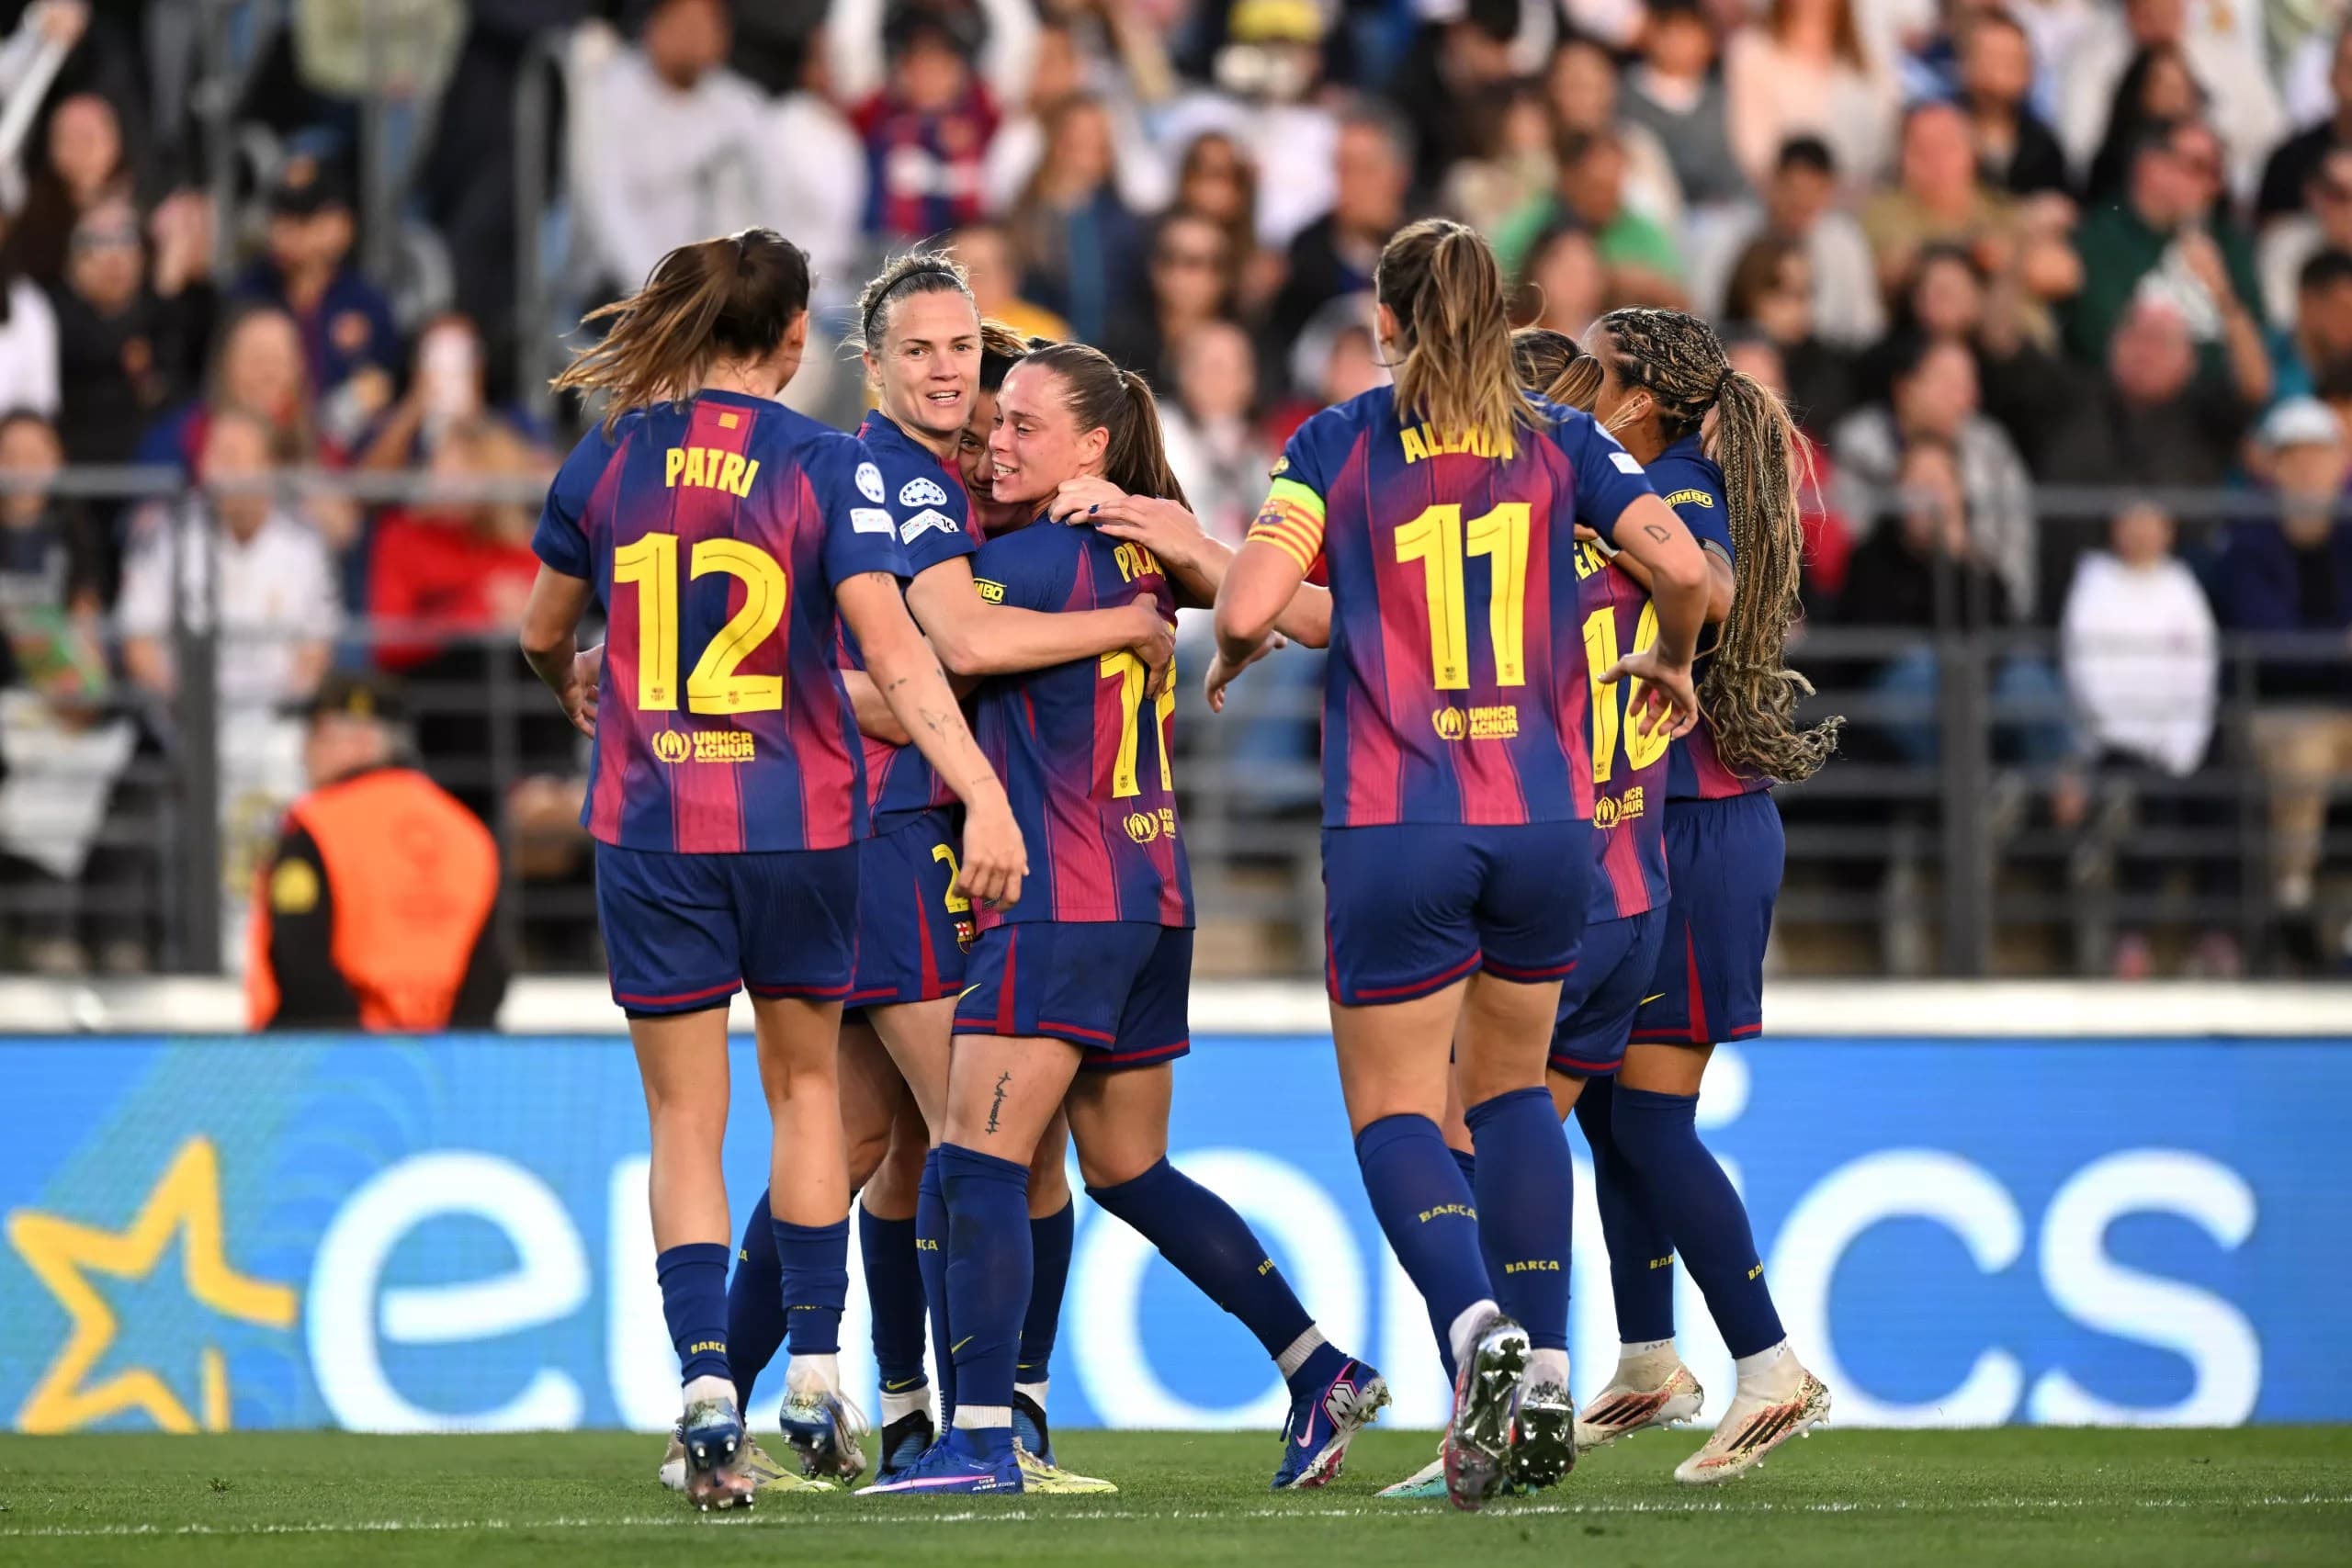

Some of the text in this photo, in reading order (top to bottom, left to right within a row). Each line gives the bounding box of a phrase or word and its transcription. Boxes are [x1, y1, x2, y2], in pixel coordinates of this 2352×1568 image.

[666, 447, 760, 498] PATRI
[1394, 502, 1532, 690] 11
[614, 531, 787, 715] 12
[1469, 705, 1518, 722] UNHCR
[1470, 720, 1520, 735] ACNUR
[692, 731, 753, 745] UNHCR
[694, 743, 755, 758] ACNUR
[1419, 1203, 1477, 1223] BARÇA
[1505, 1260, 1560, 1274] BARÇA
